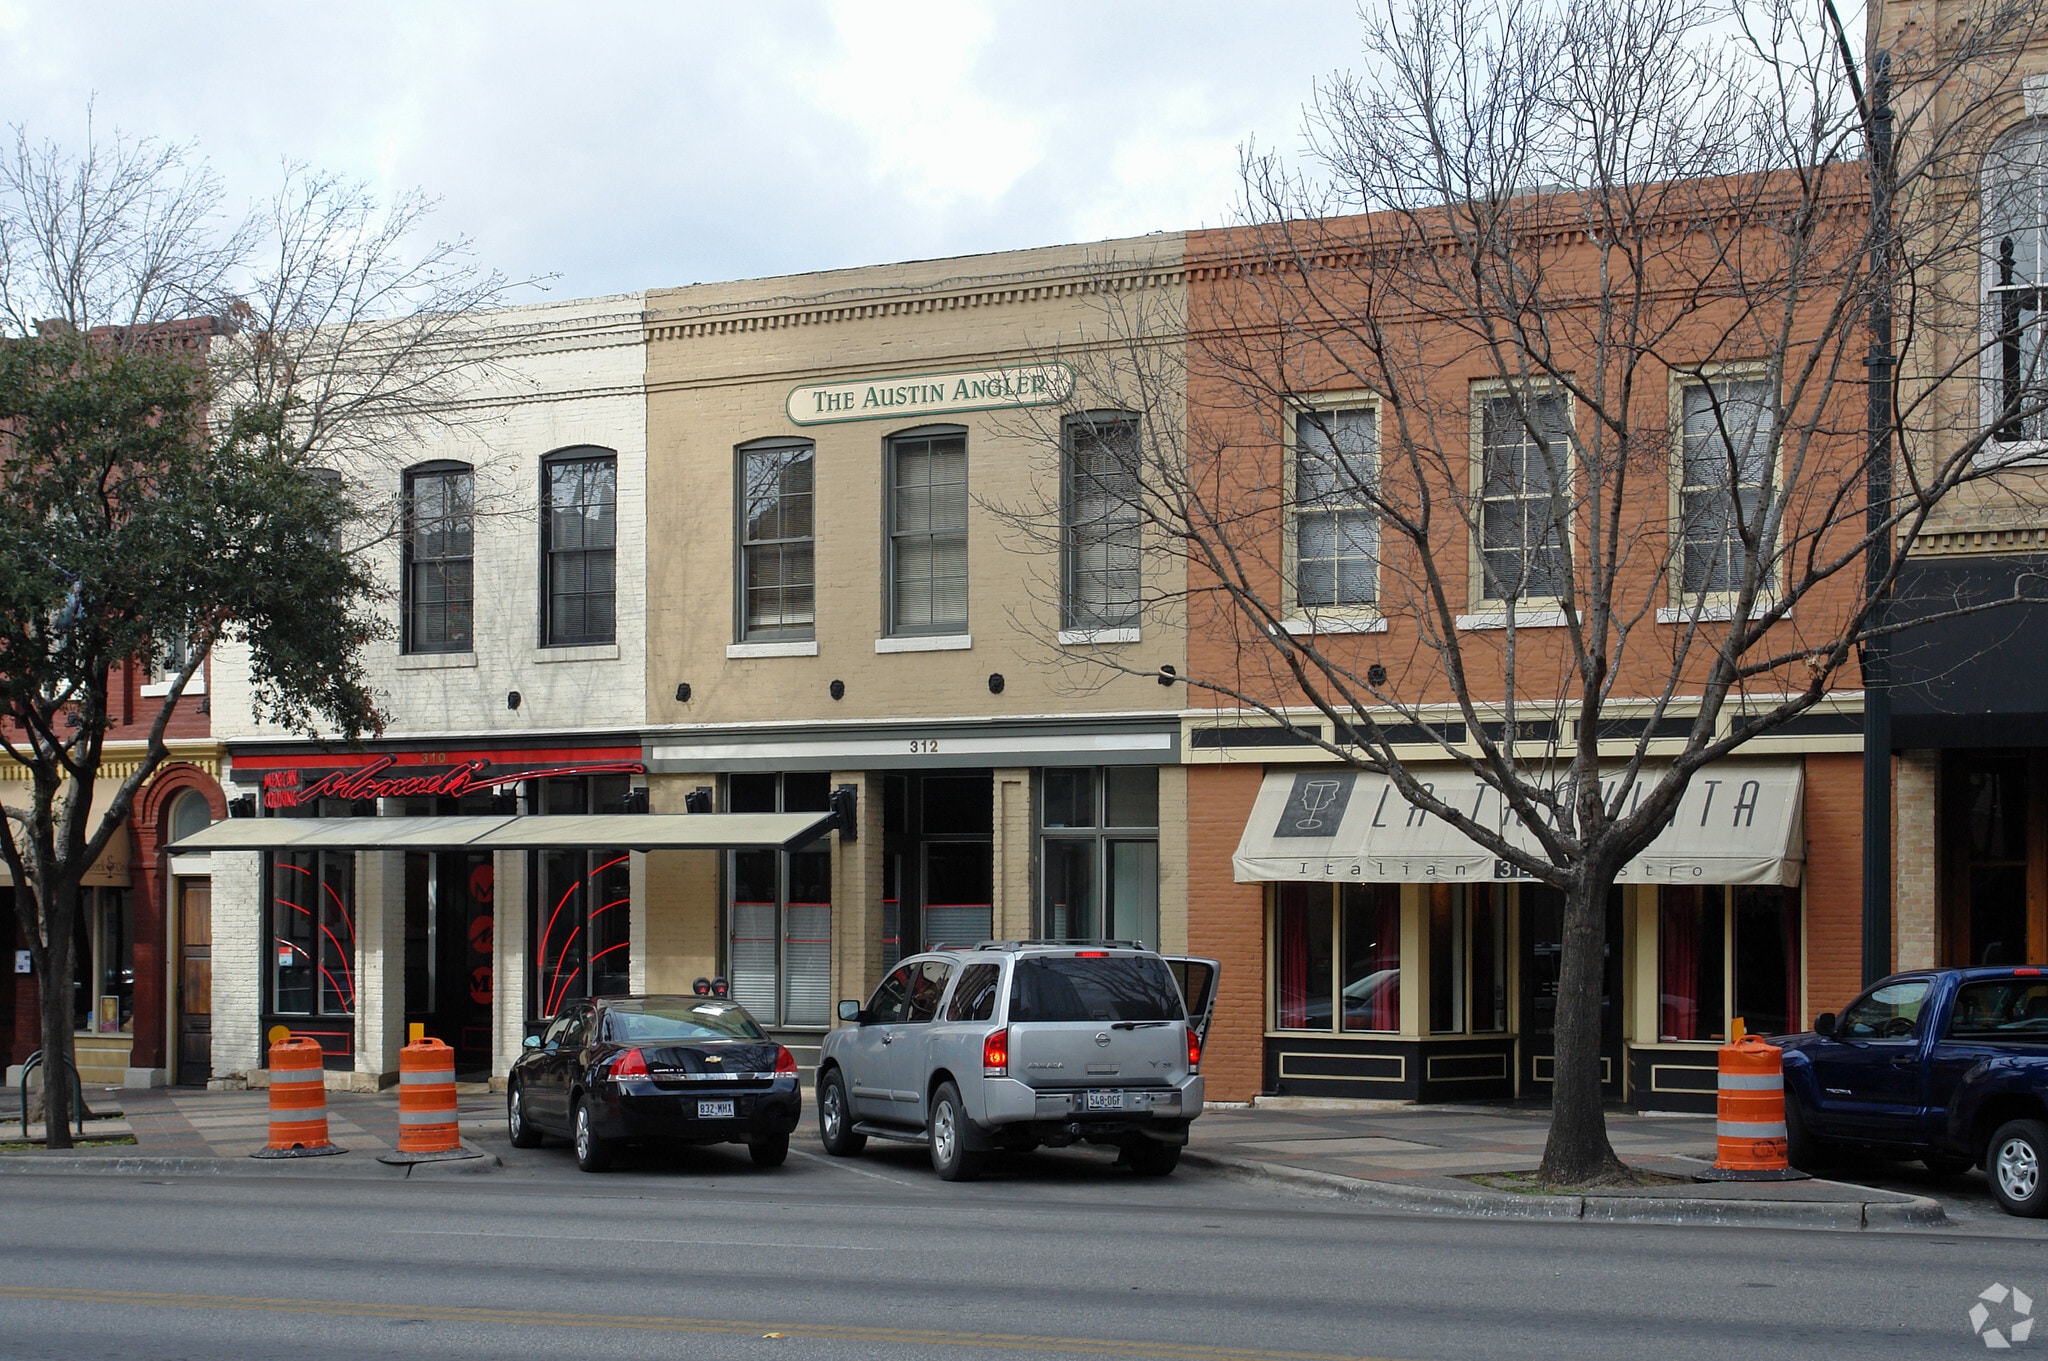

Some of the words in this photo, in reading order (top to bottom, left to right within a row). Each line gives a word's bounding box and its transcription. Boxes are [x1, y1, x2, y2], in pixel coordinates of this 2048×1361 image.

[812, 390, 855, 413] THE
[862, 382, 945, 408] AUSTIN
[952, 374, 1048, 401] ANGLER
[909, 740, 938, 753] 312
[421, 752, 447, 764] 310
[1299, 862, 1467, 876] Italian
[1618, 863, 1704, 877] stro
